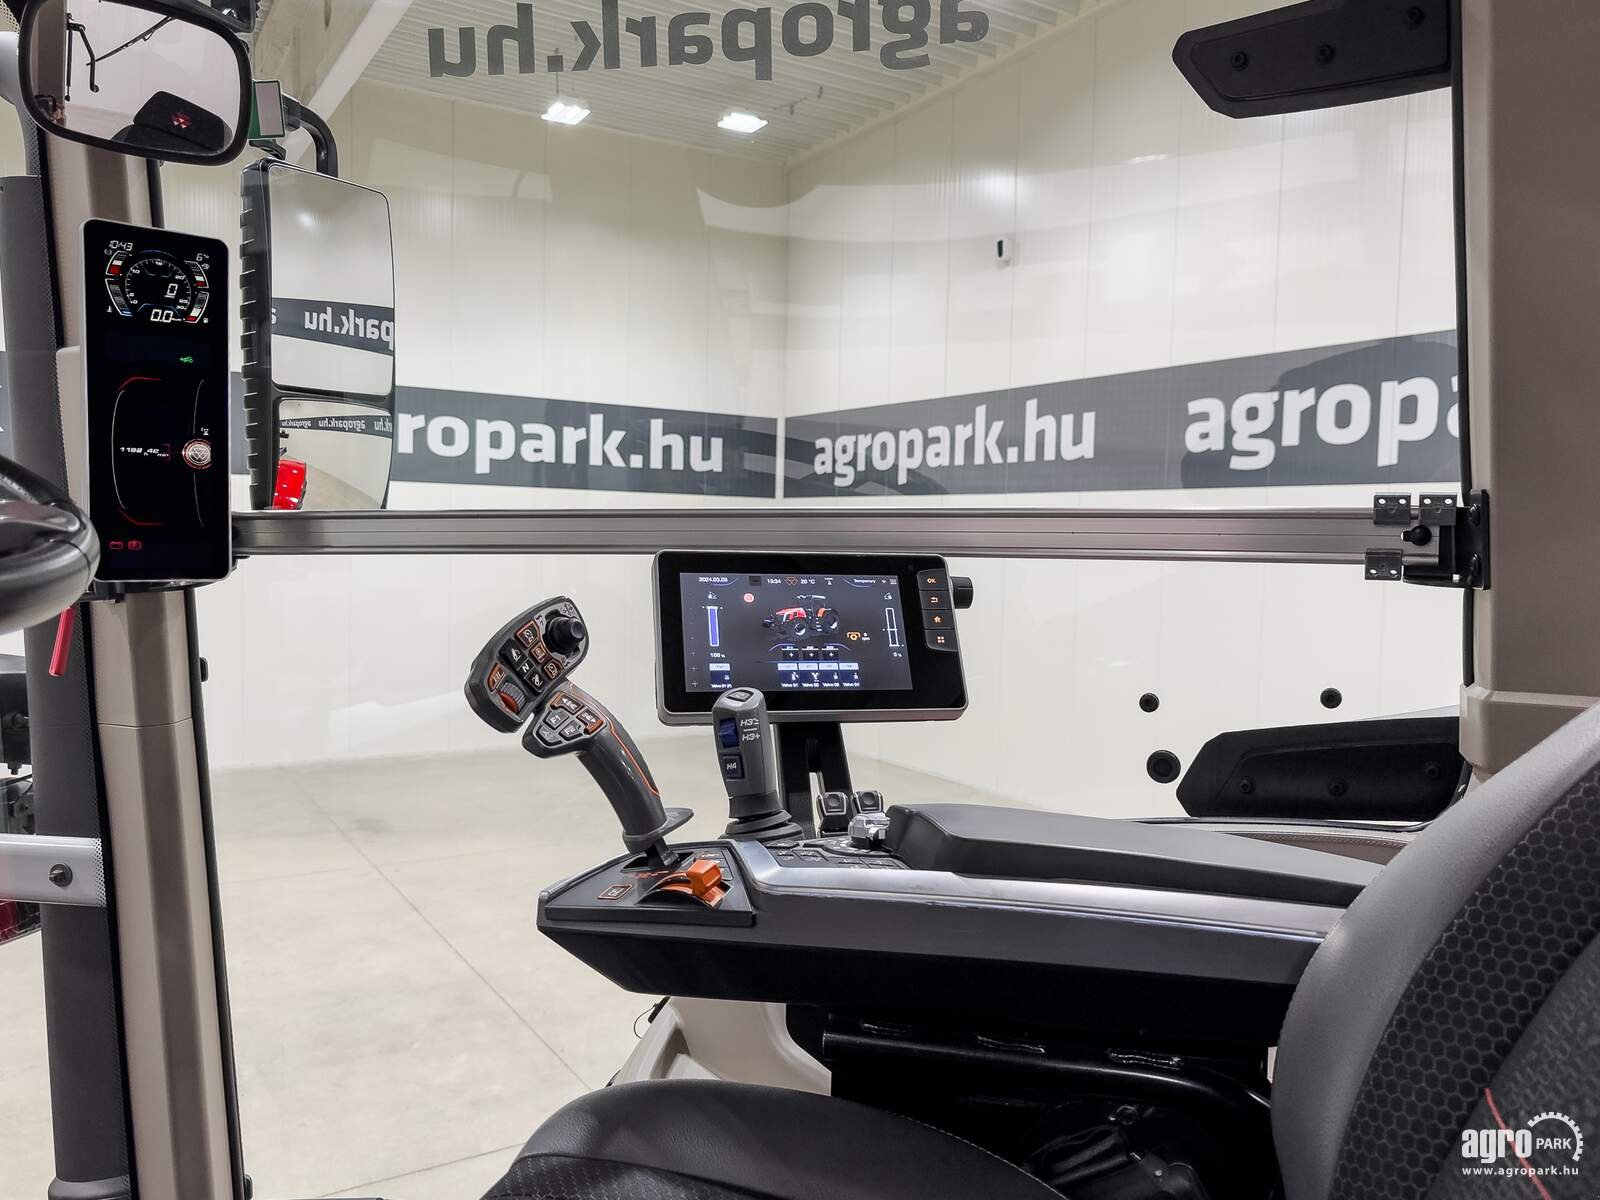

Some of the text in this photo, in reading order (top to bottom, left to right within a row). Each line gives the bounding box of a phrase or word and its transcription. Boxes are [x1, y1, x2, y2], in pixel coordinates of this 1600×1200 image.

[150, 309, 174, 323] 0.0
[397, 412, 723, 474] ropark.hu
[814, 398, 1097, 487] agropark.hu
[521, 663, 530, 673] N
[550, 714, 562, 724] F1
[564, 725, 576, 735] F2
[726, 762, 737, 770] H4
